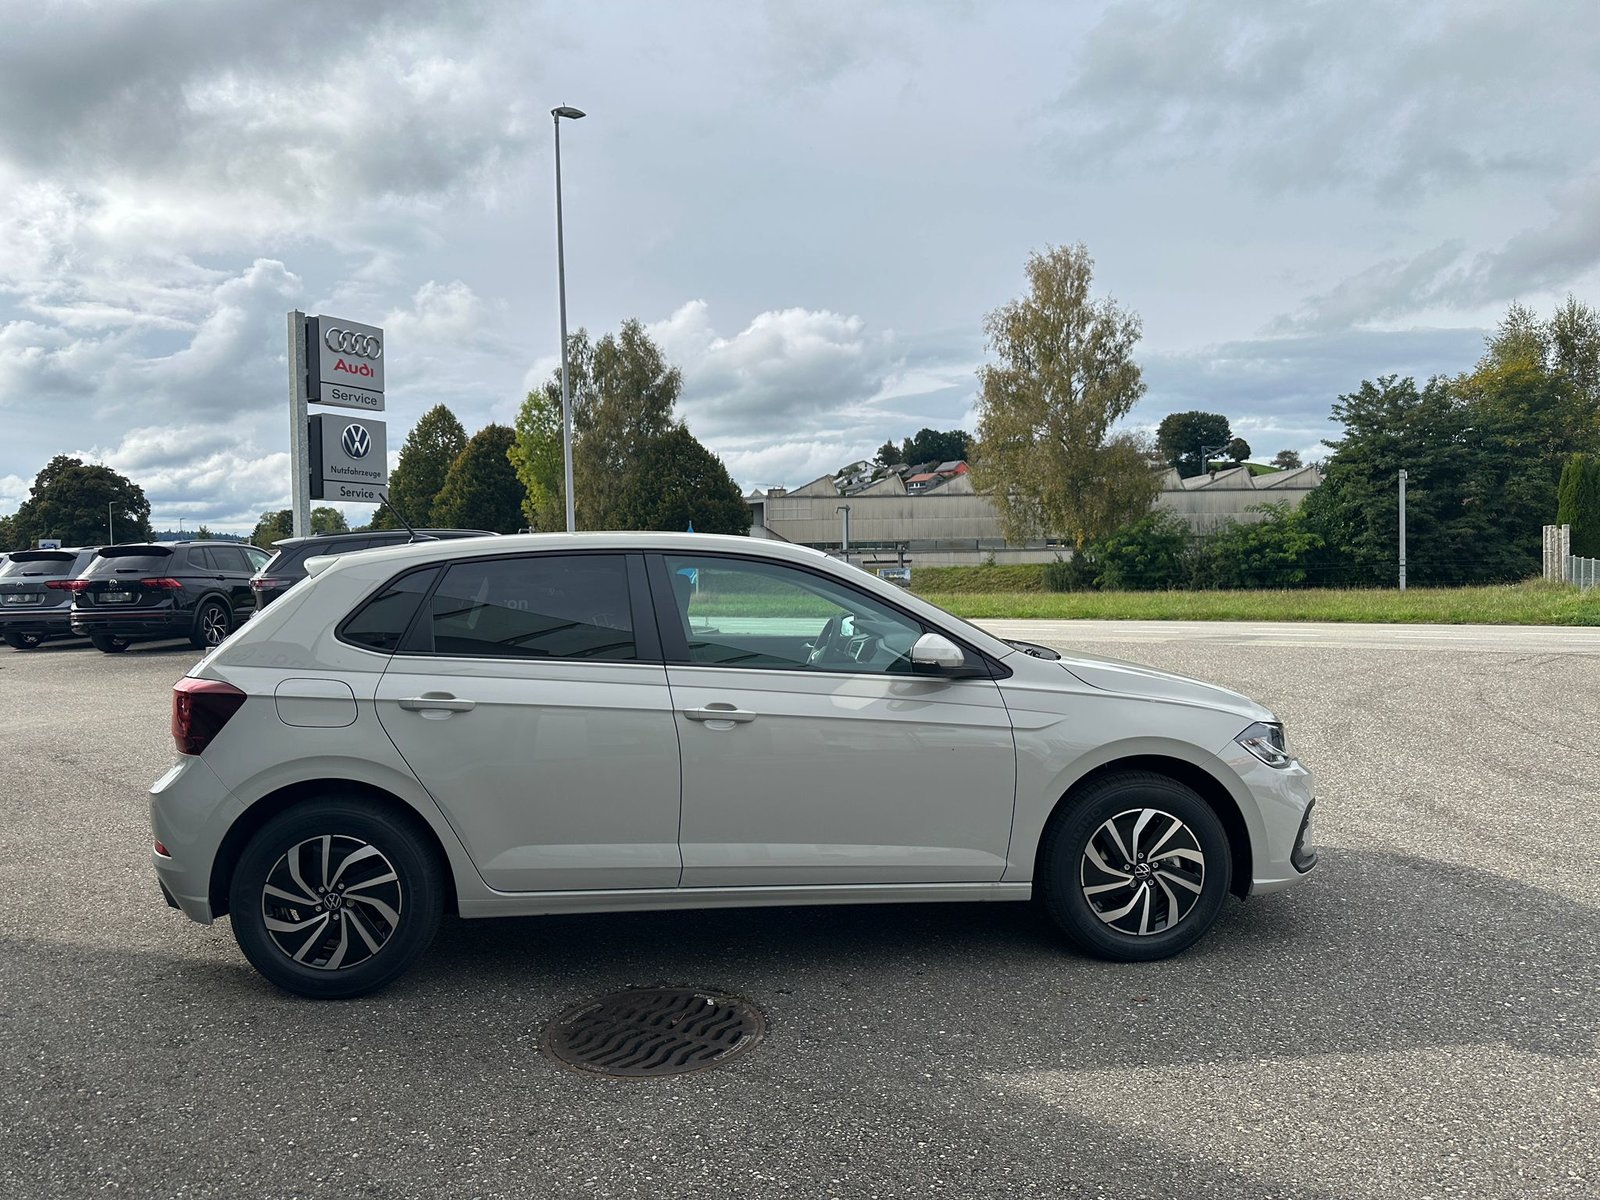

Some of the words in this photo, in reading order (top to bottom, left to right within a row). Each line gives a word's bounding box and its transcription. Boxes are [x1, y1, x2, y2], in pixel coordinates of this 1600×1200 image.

[334, 359, 374, 378] Audi
[332, 388, 377, 406] Service
[342, 424, 371, 459] VW
[330, 465, 382, 479] Nutzfahrzeuge
[340, 486, 374, 499] Service
